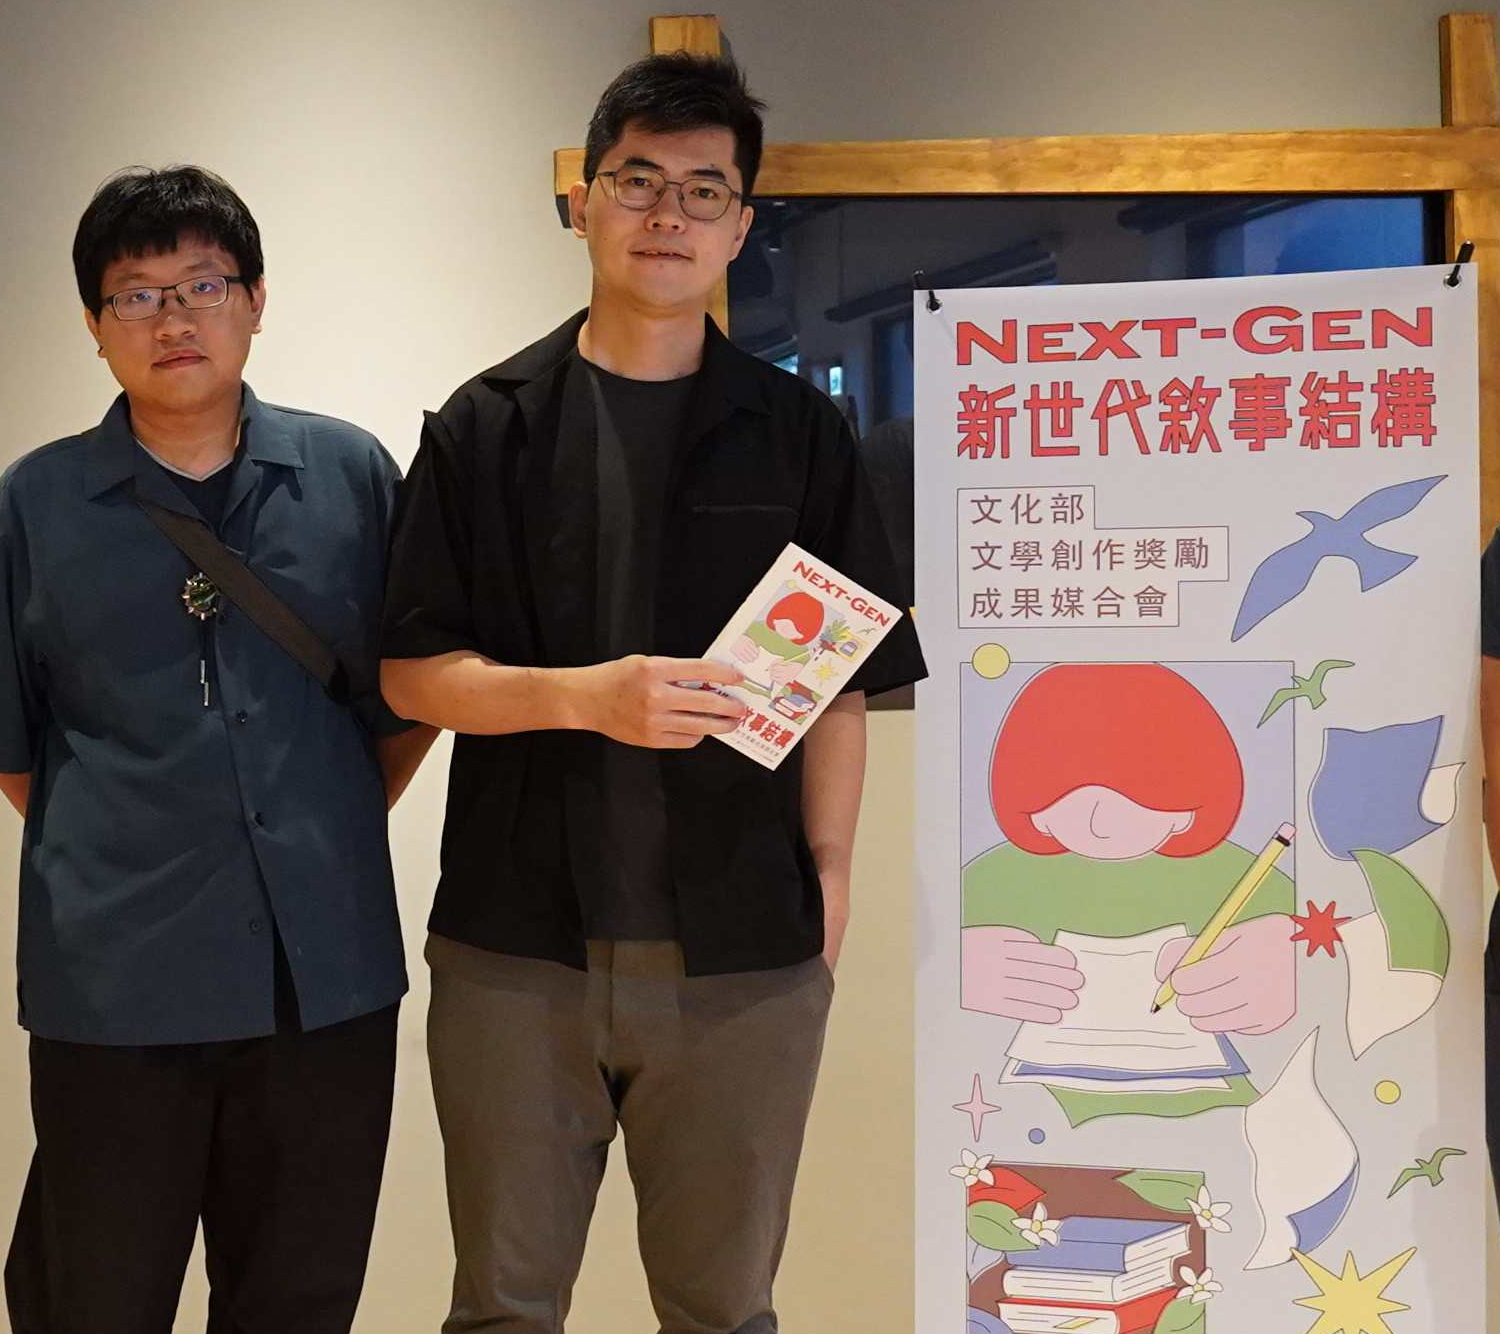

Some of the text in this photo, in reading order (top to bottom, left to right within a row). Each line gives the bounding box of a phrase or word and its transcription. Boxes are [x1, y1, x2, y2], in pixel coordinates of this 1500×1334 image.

[957, 306, 1433, 366] NEXT-GEN
[957, 368, 1437, 459] 新世代敘事結構
[970, 492, 1086, 525] 文化部
[970, 537, 1210, 571] 文學創作獎勵
[792, 560, 891, 628] NEXT-GEN
[969, 585, 1168, 620] 成果媒合會
